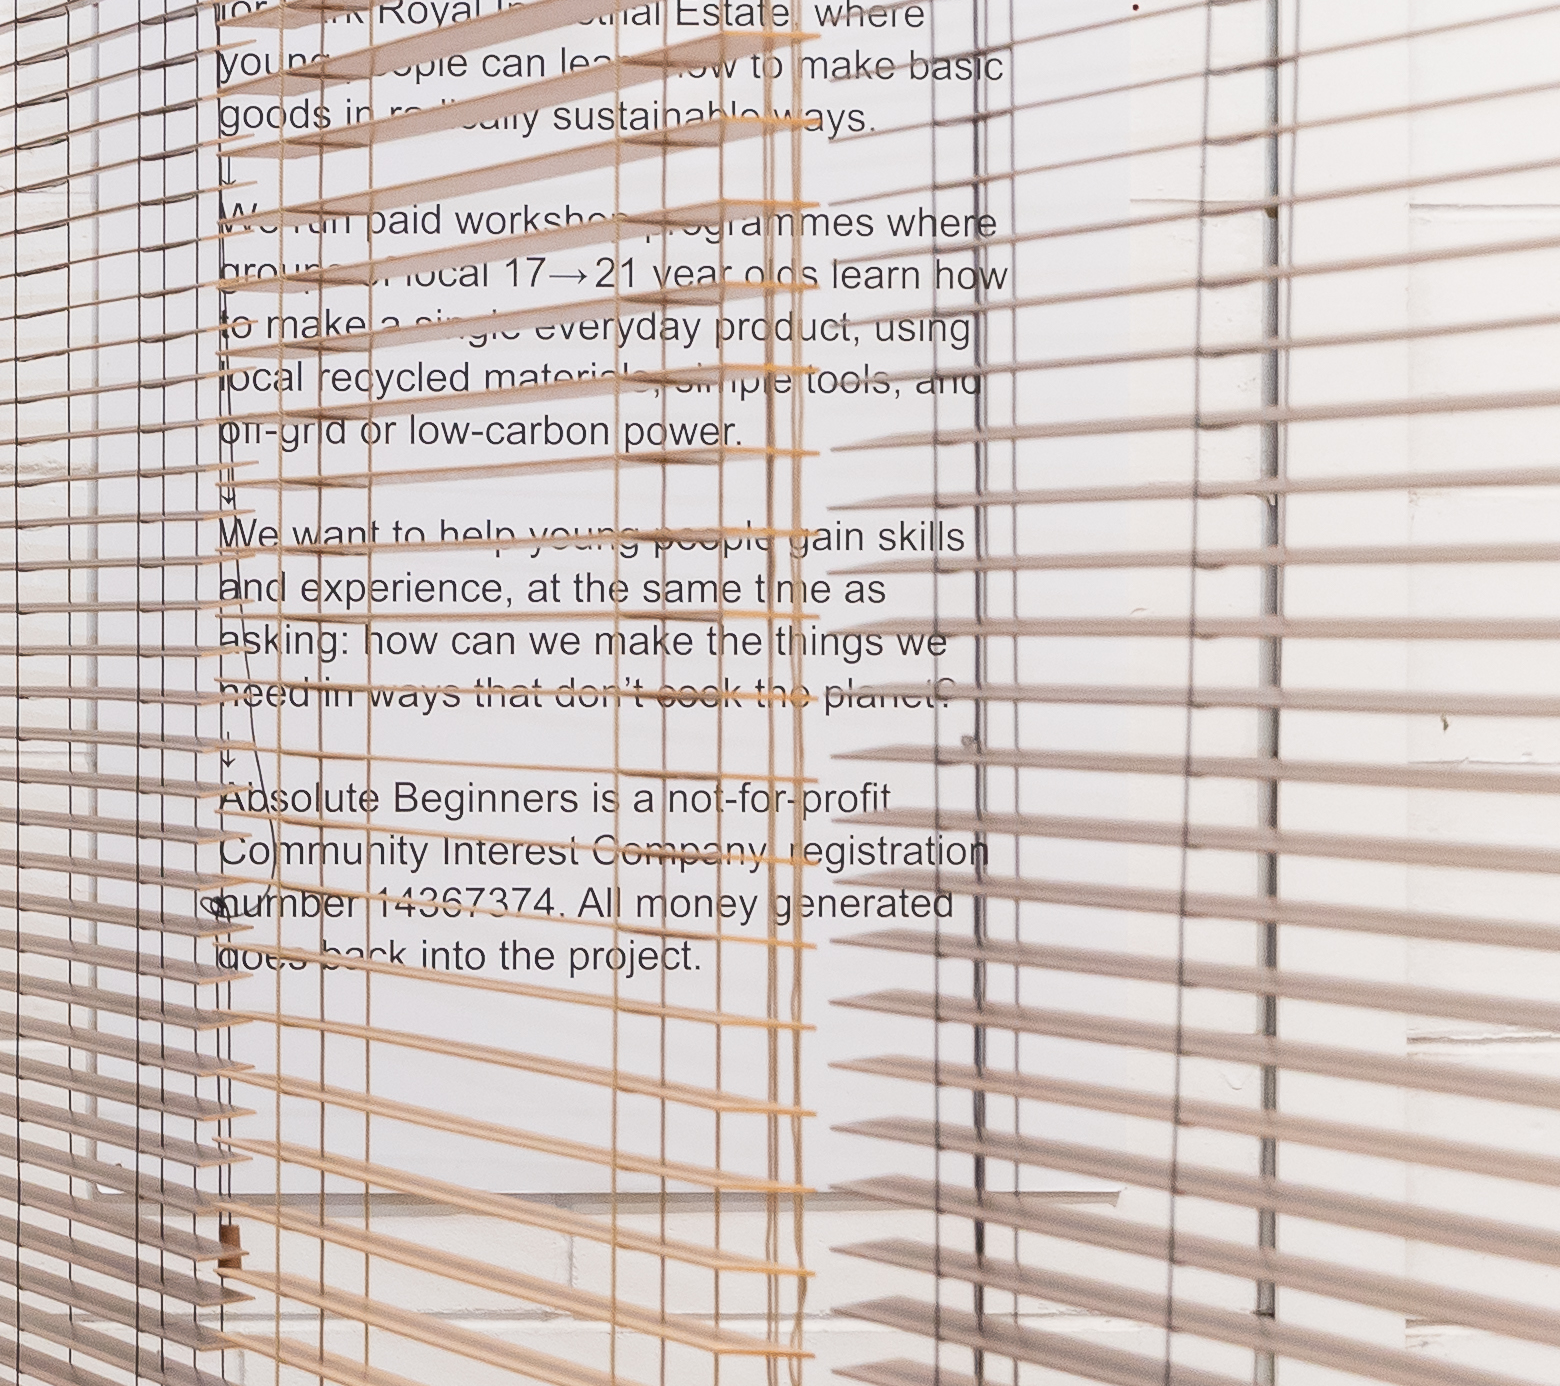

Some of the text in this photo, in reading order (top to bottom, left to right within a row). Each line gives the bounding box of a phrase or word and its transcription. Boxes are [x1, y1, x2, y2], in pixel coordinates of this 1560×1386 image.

[482, 55, 544, 77] can
[679, 54, 736, 79] ow
[752, 54, 782, 79] to
[802, 51, 895, 79] make
[910, 50, 1003, 80] basic
[220, 98, 331, 136] goods
[346, 98, 372, 126] in
[774, 109, 875, 140] ays.
[295, 211, 350, 234] un
[367, 204, 441, 241] paid
[456, 205, 626, 235] worksho
[887, 207, 996, 237] where
[653, 264, 732, 293] year
[745, 258, 818, 287] ods
[833, 259, 919, 289] learn
[935, 260, 1008, 290] how
[268, 309, 366, 338] make
[535, 312, 700, 348] everyday
[716, 311, 859, 348] product,
[876, 318, 970, 350] using
[221, 361, 302, 392] local
[321, 362, 469, 399] recycled
[807, 364, 900, 398] tools,
[916, 369, 981, 394] and
[220, 414, 741, 452] off-grd or low-carbon power.
[220, 518, 279, 547] We
[293, 521, 379, 544] want
[393, 520, 425, 542] to
[441, 519, 515, 557] help
[790, 521, 863, 558] gain
[878, 521, 965, 551] skills
[220, 571, 885, 610] and experience, at the same tme as
[221, 624, 946, 664] asking: how can we make the things we
[221, 678, 308, 707] need
[325, 678, 353, 707] in
[371, 685, 461, 715] ways
[475, 678, 542, 707] that
[756, 680, 810, 708] the
[220, 781, 891, 821] Absolute Beginners is a not-for-profit
[220, 835, 428, 873] Community
[444, 837, 578, 865] Interest
[790, 836, 988, 873] registration
[220, 886, 953, 925] number 14367374. All money generated
[322, 940, 406, 970] back
[422, 940, 485, 970] into
[501, 940, 554, 970] the
[570, 940, 700, 978] project.
